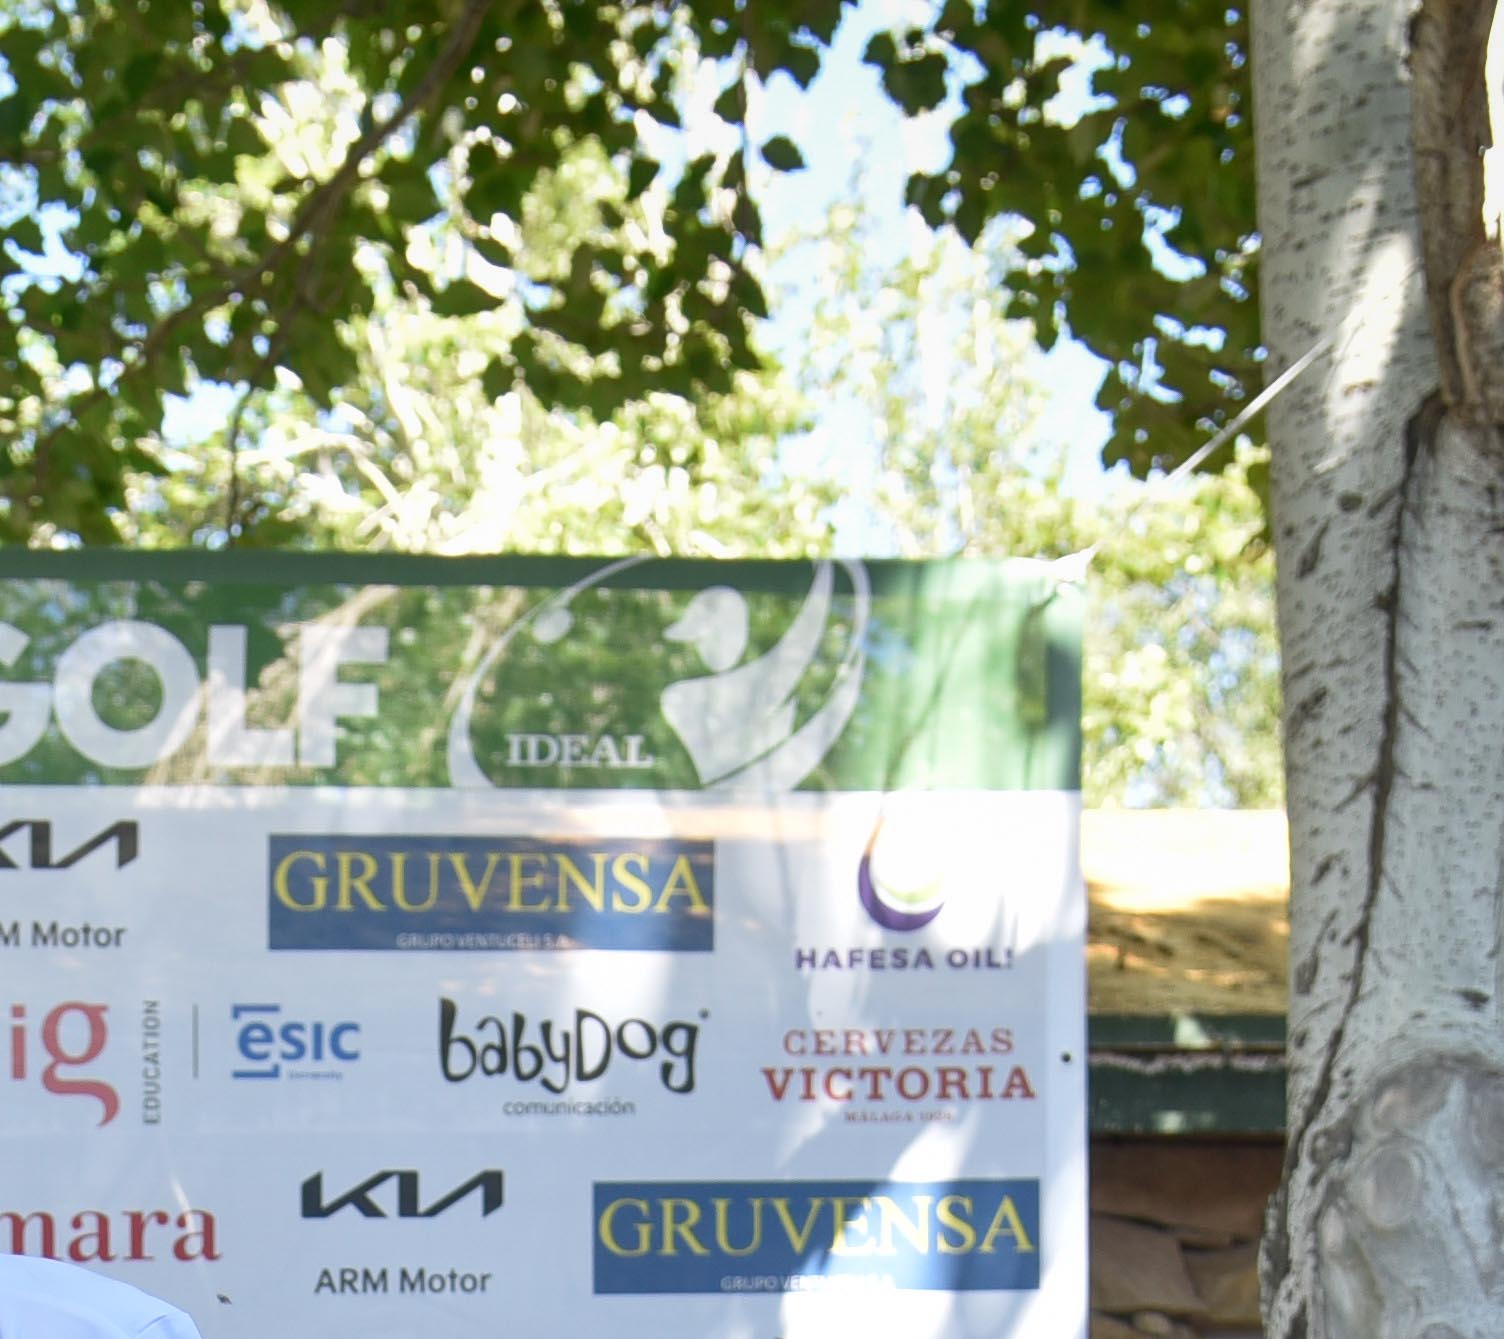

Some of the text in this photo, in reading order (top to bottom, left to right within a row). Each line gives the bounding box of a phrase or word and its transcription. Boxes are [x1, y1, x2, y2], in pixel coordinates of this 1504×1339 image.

[505, 733, 655, 770] IDEAL
[272, 849, 712, 914] GRUVENSA
[31, 920, 128, 949] Motor
[796, 948, 1015, 971] HAFESA OIL!
[781, 1027, 1015, 1058] CERVEZAS
[143, 1000, 161, 1126] EDUCATION
[760, 1064, 1037, 1103] VICTORIA
[502, 1098, 636, 1118] comunicación
[597, 1195, 1038, 1258] GRUVENSA
[314, 1267, 492, 1294] ARM Motor
